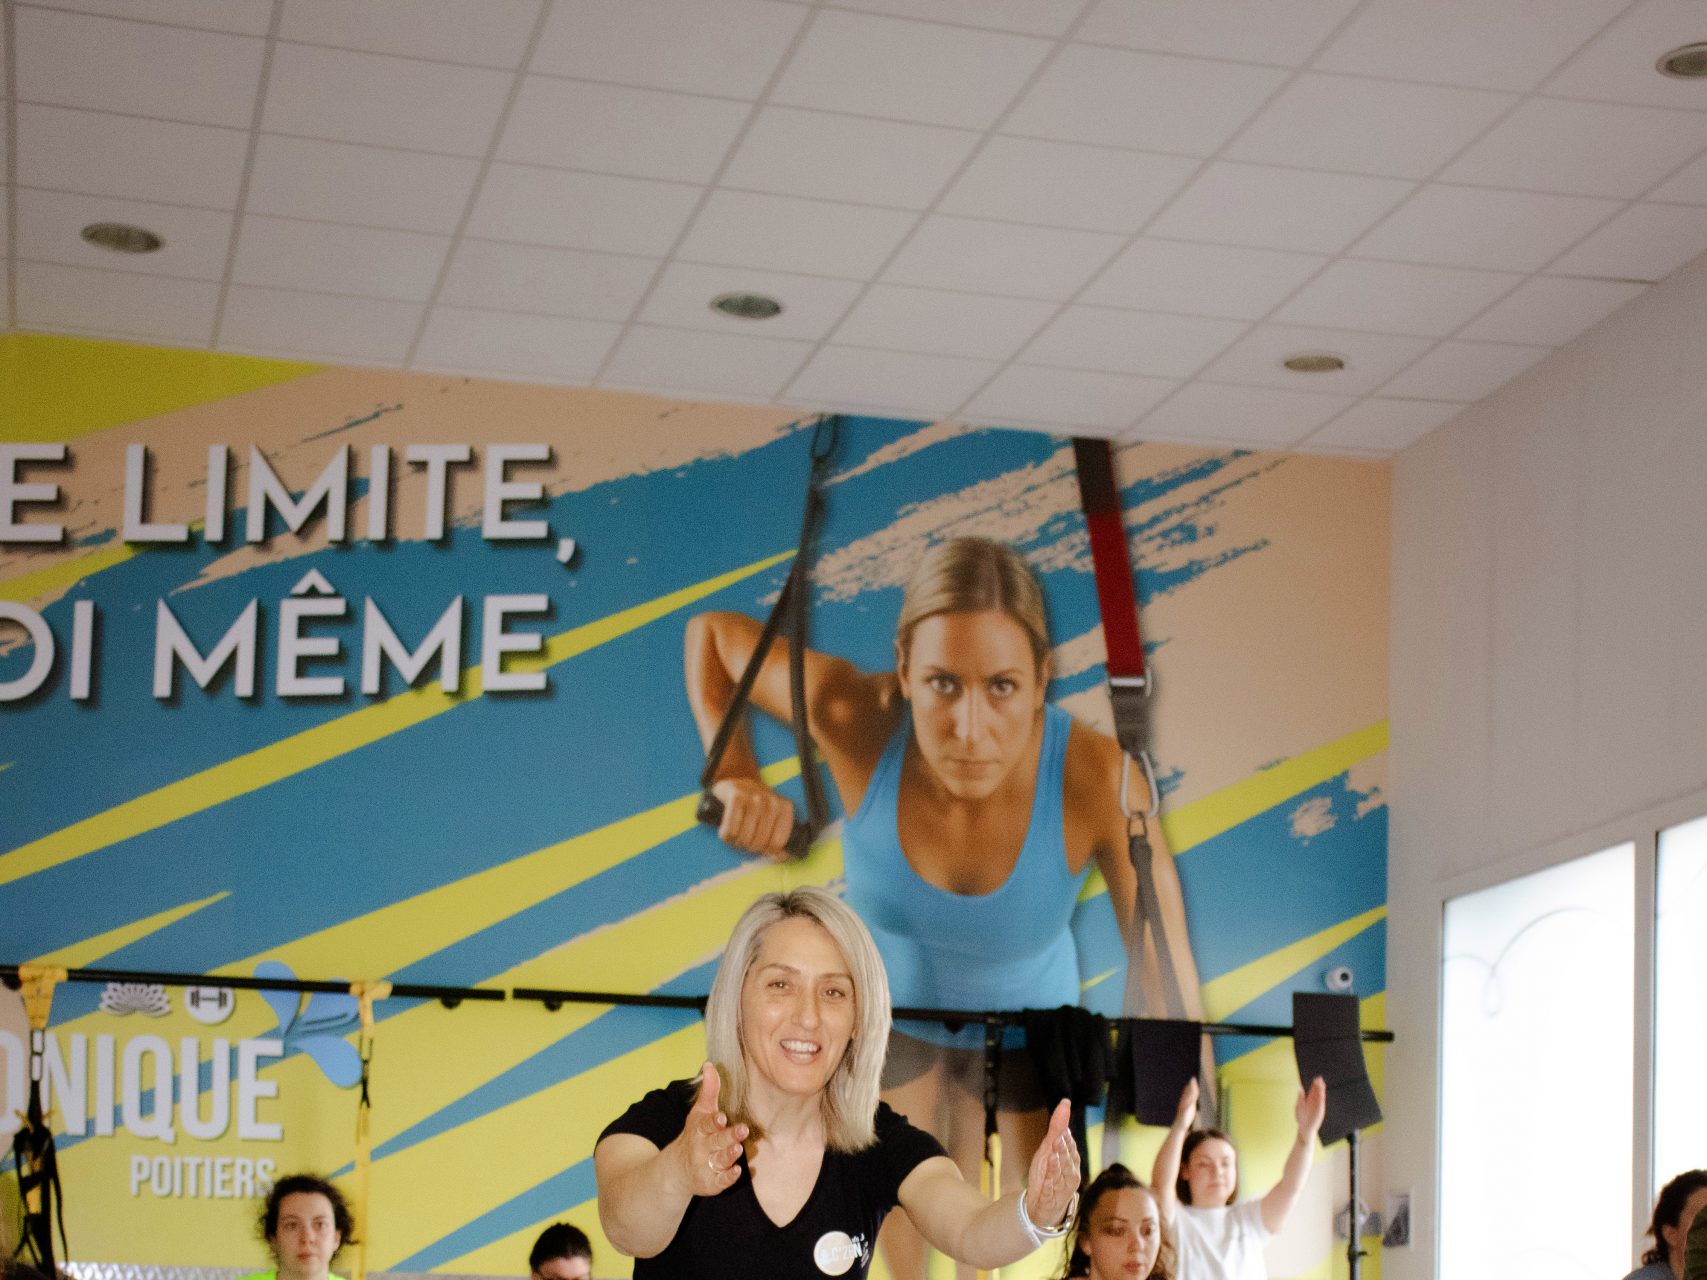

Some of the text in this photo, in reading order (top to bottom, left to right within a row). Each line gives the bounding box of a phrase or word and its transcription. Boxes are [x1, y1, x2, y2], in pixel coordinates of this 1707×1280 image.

[0, 443, 576, 564] E LIMITE,
[153, 568, 549, 698] MÊME
[131, 1154, 277, 1198] POITIERS
